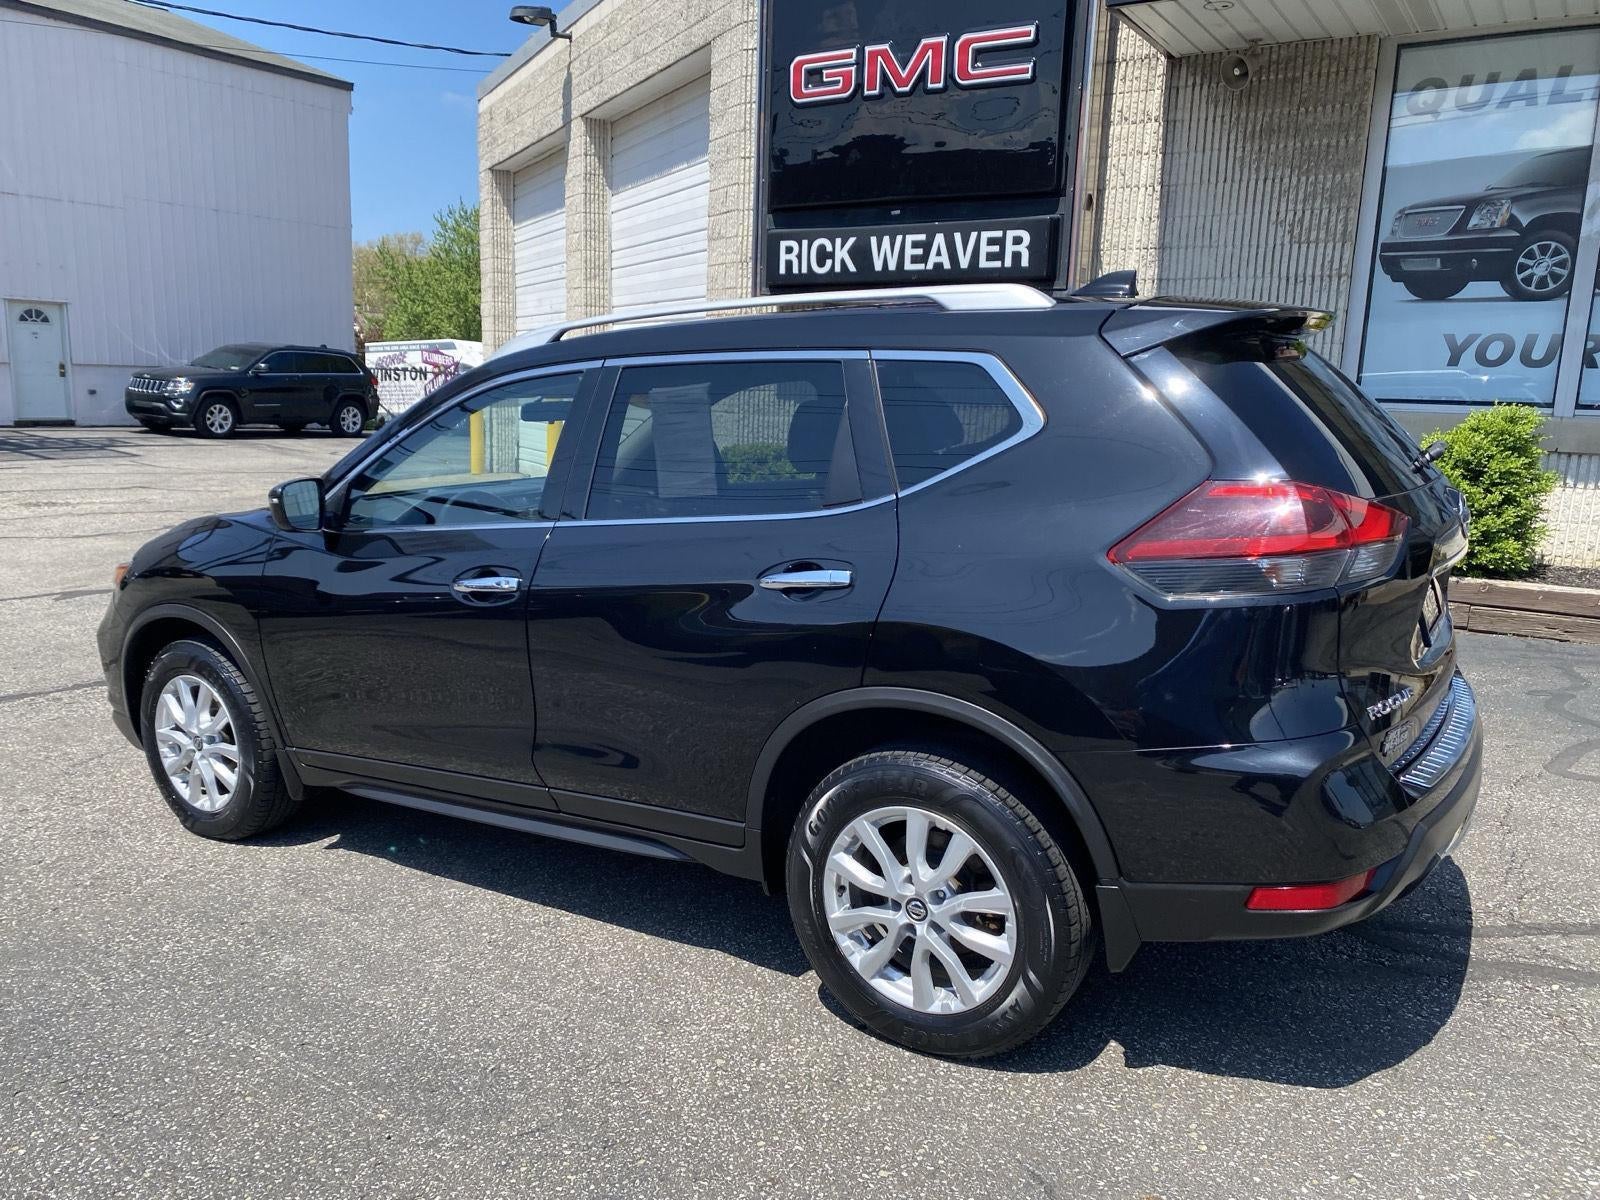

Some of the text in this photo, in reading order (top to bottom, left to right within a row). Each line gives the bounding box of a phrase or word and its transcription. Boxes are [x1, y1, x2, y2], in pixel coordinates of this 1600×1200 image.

[790, 23, 1038, 104] GMC
[1405, 63, 1598, 121] QUAL
[778, 229, 1032, 275] RICK WEAVER
[374, 351, 408, 369] GEORGE
